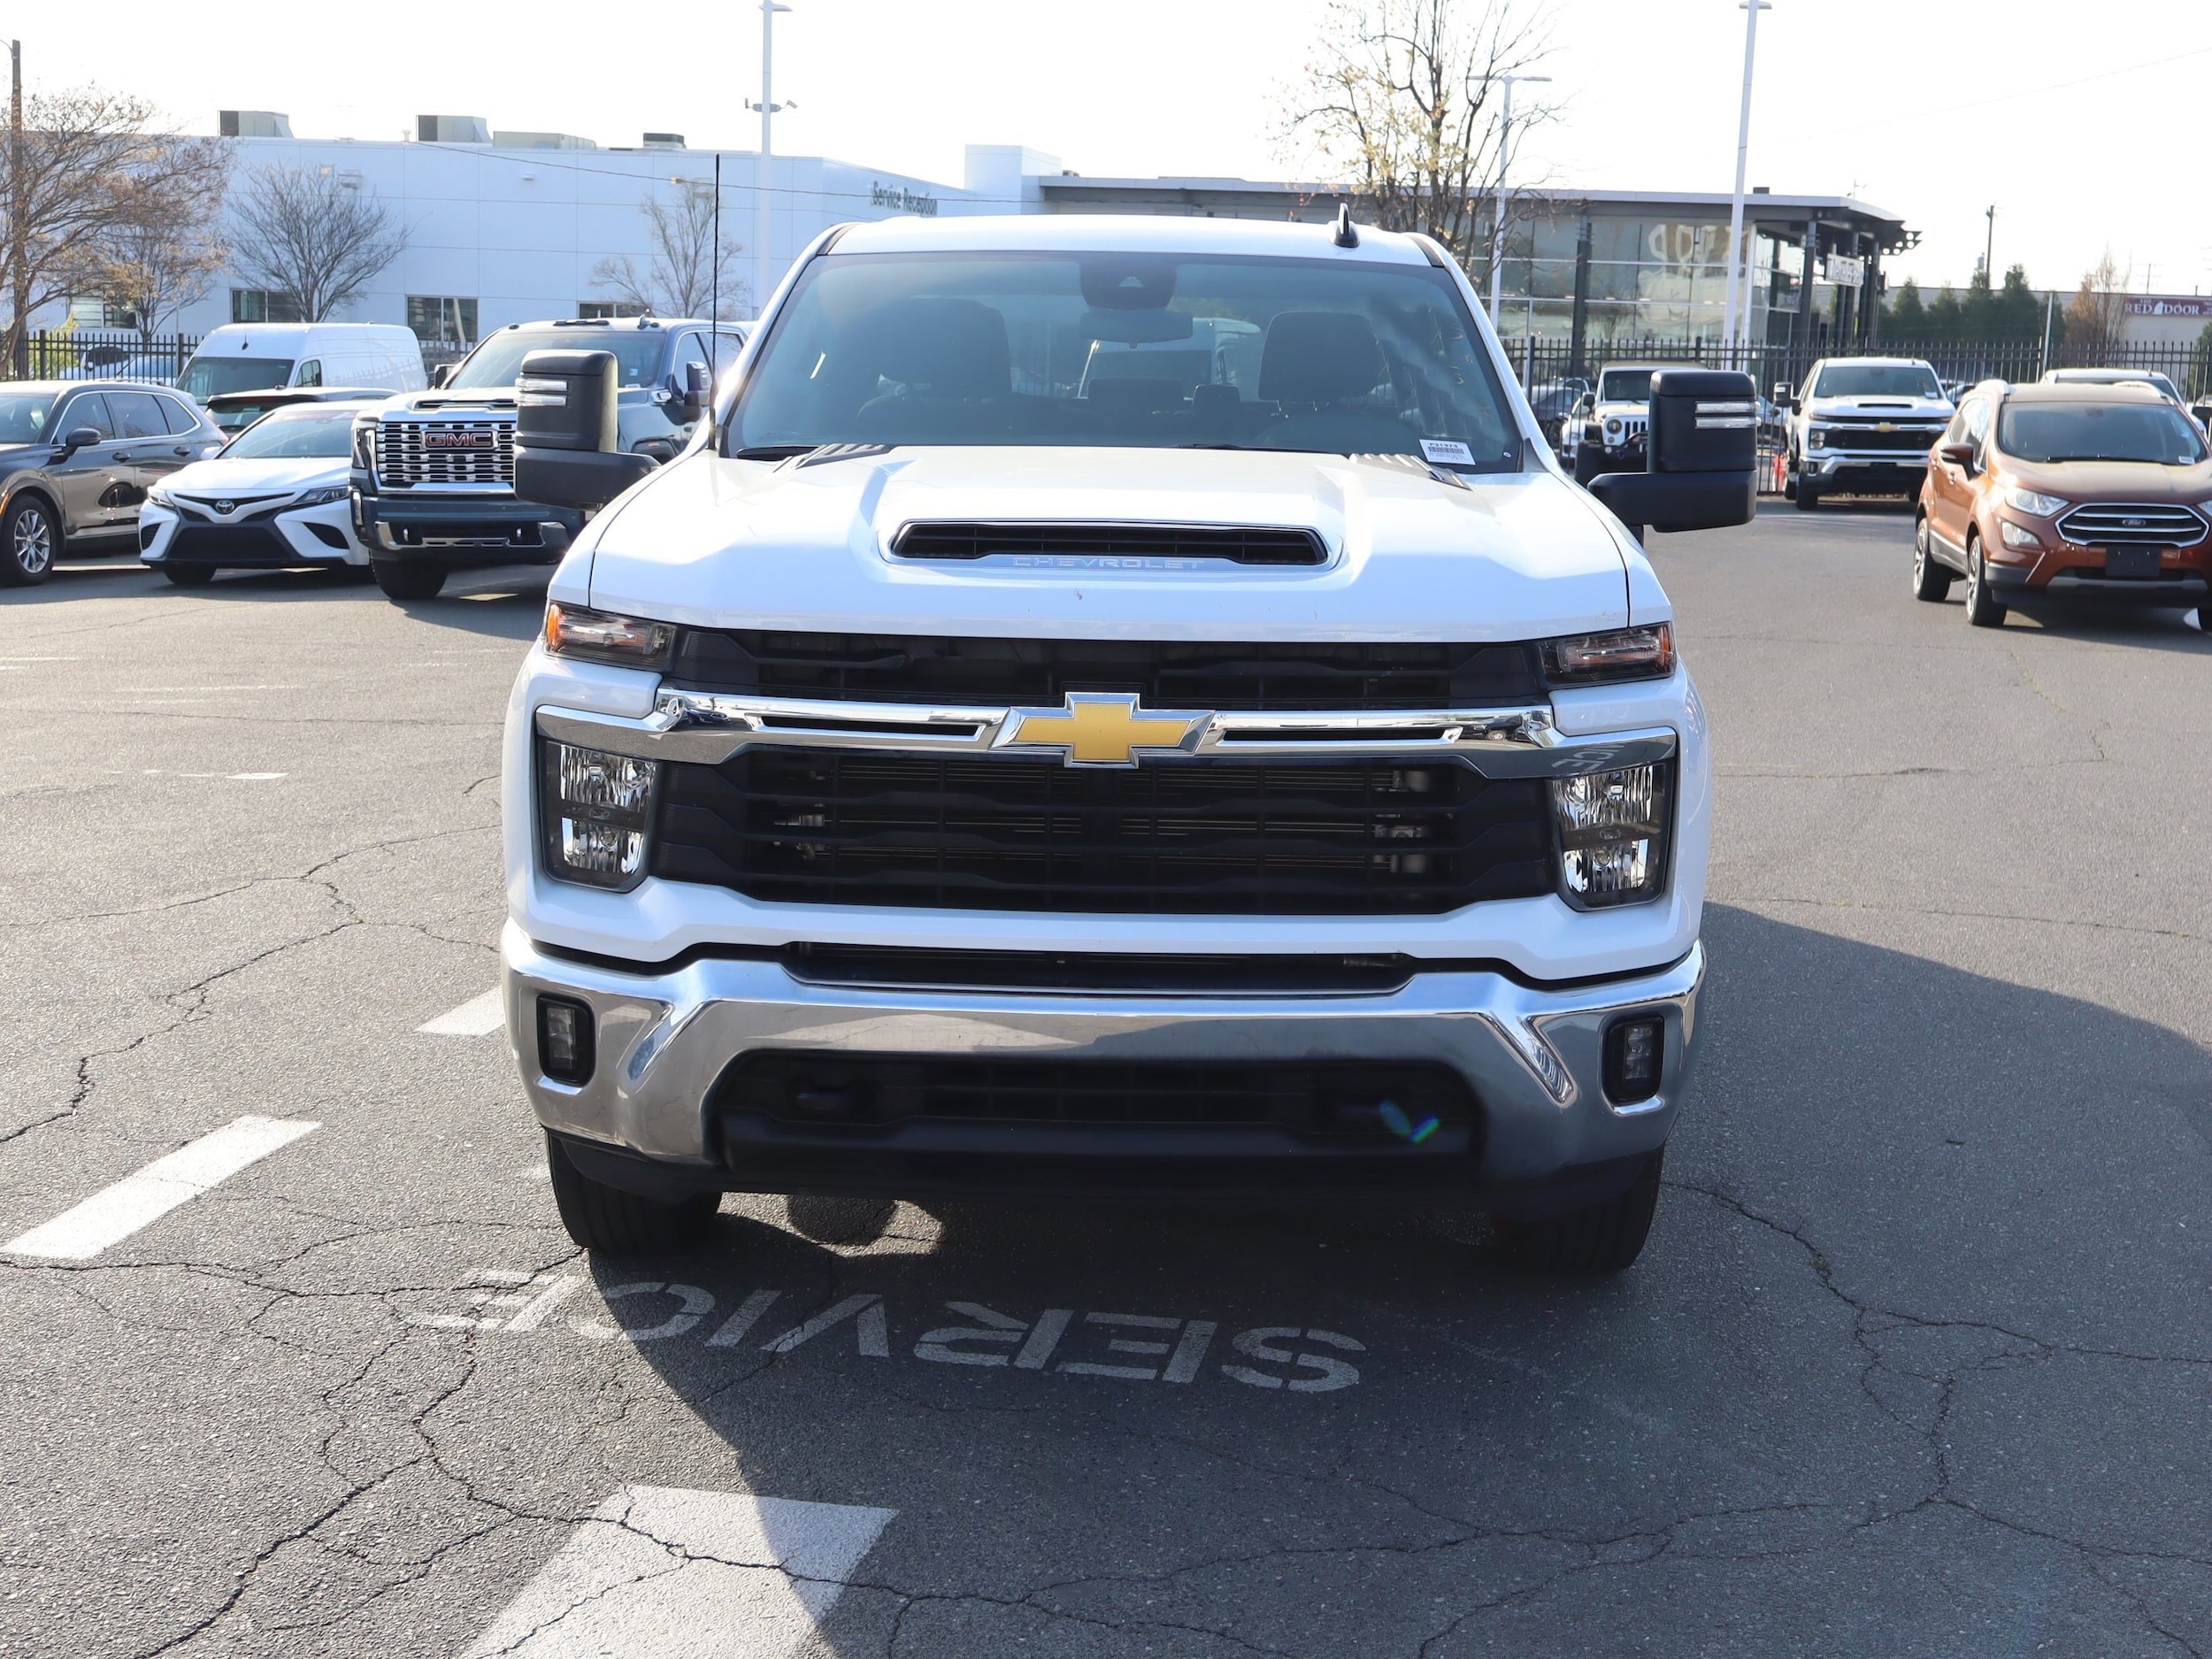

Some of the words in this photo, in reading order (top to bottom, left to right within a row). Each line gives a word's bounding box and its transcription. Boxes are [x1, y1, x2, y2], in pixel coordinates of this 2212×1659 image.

[872, 180, 901, 209] Service
[903, 188, 938, 216] Reception
[2125, 303, 2152, 314] RED
[2164, 303, 2200, 315] DOOR
[426, 432, 492, 447] GMC
[1012, 557, 1204, 569] CHEVROLET
[406, 1269, 1366, 1392] SERVICE
